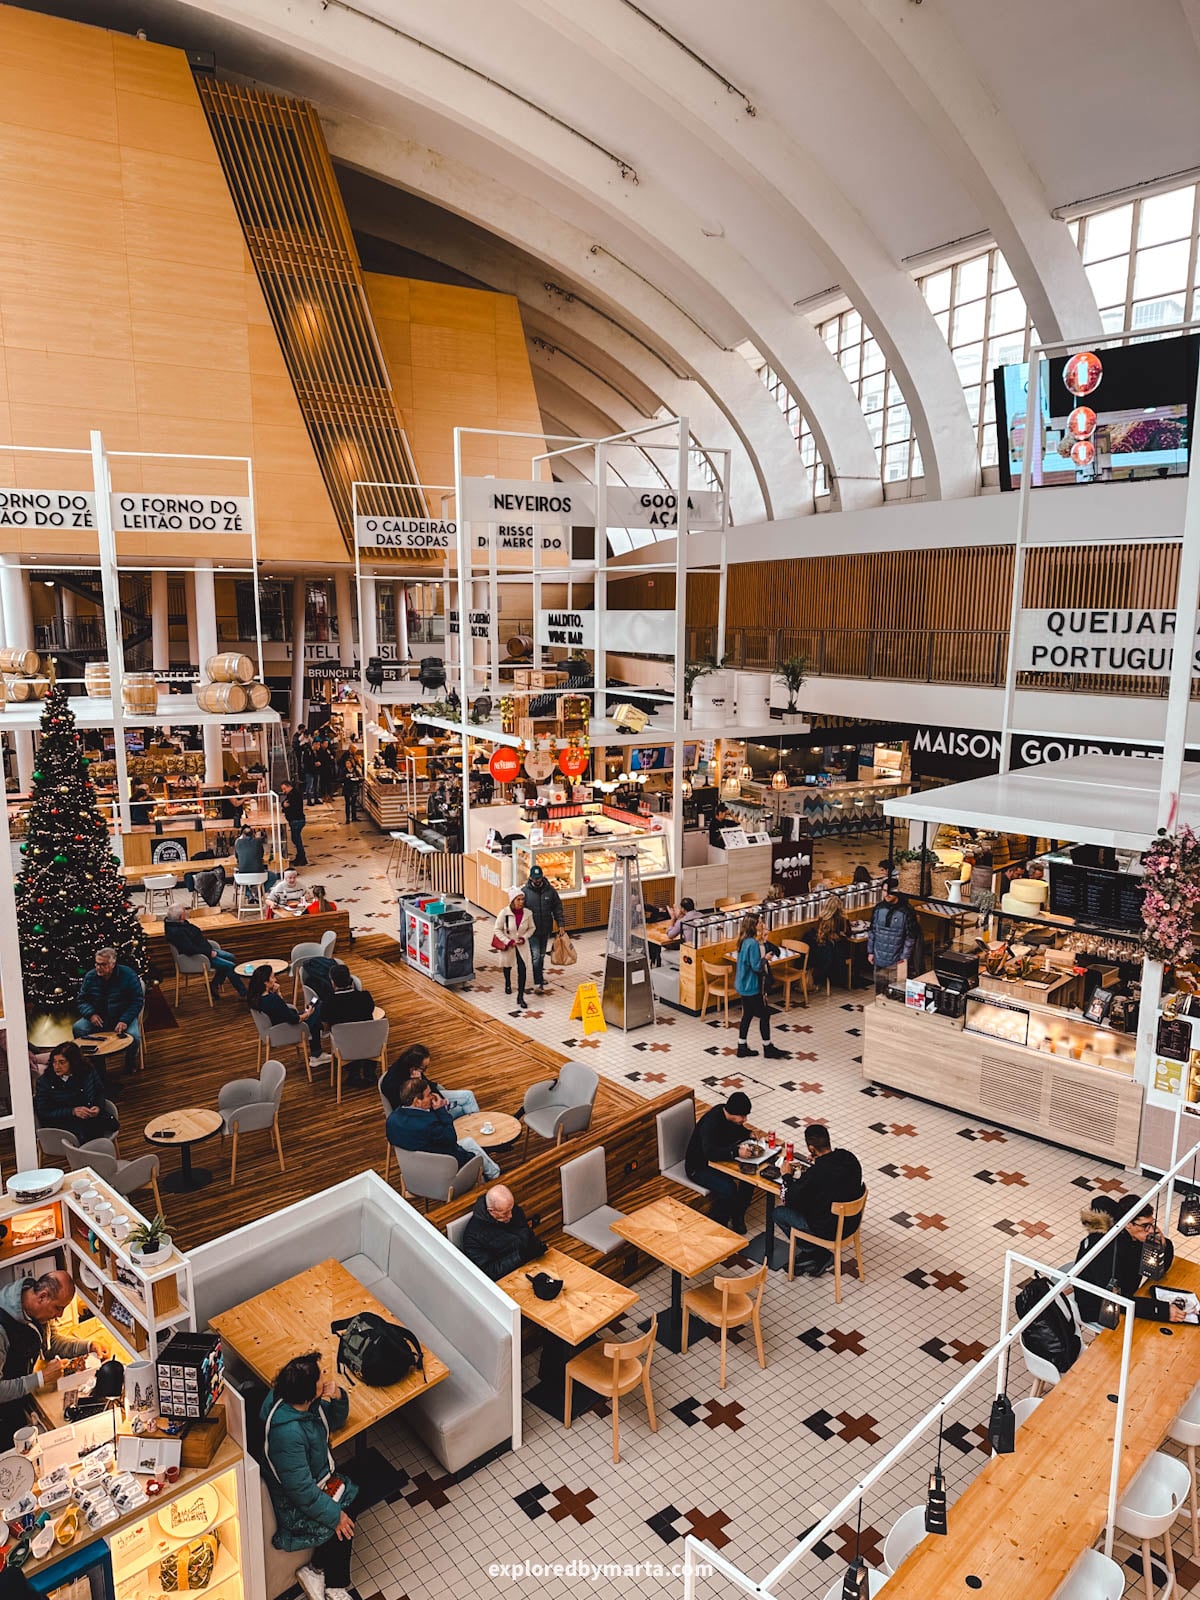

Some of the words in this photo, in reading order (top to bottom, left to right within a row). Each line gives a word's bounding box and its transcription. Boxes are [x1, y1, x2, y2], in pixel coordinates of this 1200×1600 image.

[0, 492, 51, 509] ORNO
[58, 495, 87, 510] DO
[120, 497, 135, 512] O
[142, 499, 204, 515] FORNO
[211, 500, 238, 515] DO
[494, 494, 572, 513] NEVEIROS
[640, 494, 694, 510] GOOA
[0, 507, 27, 525] ÃO
[35, 511, 64, 526] DO
[72, 509, 93, 527] ZÉ
[123, 512, 183, 530] LEITÃO
[189, 516, 217, 531] DO
[223, 514, 243, 531] ZÉ
[649, 511, 678, 528] AÇA
[366, 519, 378, 532] O
[382, 520, 457, 534] CALDEIRÃO
[499, 525, 534, 537] RISSO
[376, 534, 402, 545] DAS
[407, 534, 449, 547] SOPAS
[502, 537, 562, 549] MERCDO
[1047, 611, 1200, 637] QUEIJAR
[286, 645, 333, 659] HTEL
[1031, 645, 1200, 672] PORTUGU
[308, 668, 349, 678] BRUNCH
[913, 729, 1002, 760] MAISON
